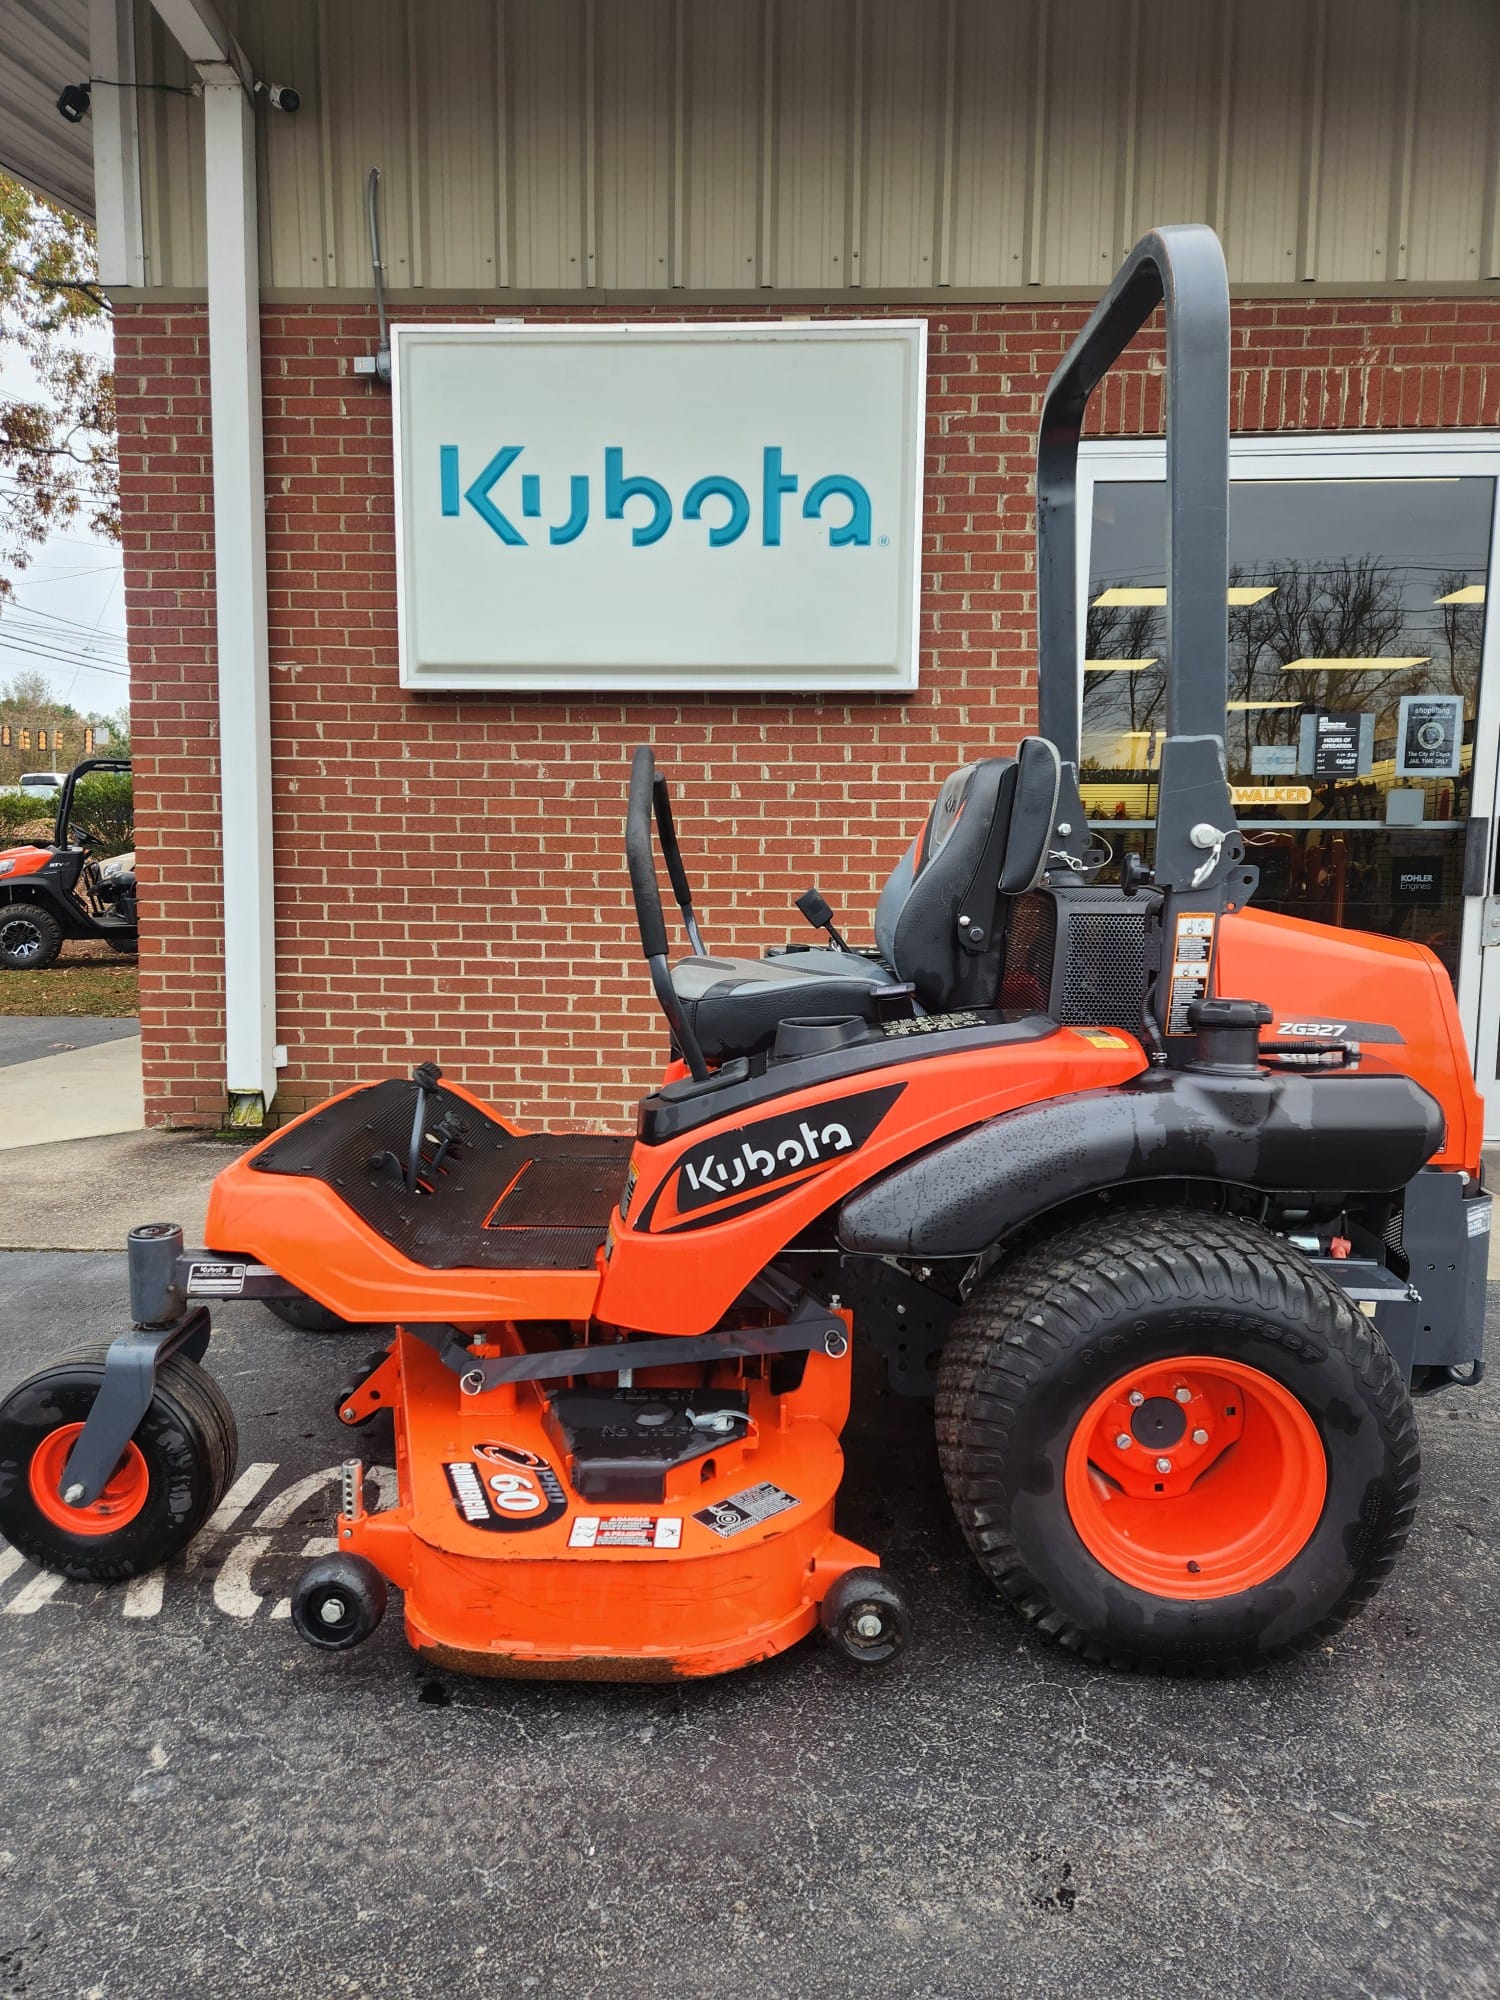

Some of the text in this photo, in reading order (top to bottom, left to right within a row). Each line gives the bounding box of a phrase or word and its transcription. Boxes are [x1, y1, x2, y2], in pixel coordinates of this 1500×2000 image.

[440, 445, 872, 547] Kubota
[1235, 788, 1307, 802] WALKER
[1400, 882, 1432, 891] Engines
[1401, 874, 1433, 882] KOHLER
[1276, 1022, 1347, 1037] ZG327
[685, 1122, 853, 1193] Kubota
[449, 1462, 490, 1521] COMMERCIAL
[490, 1473, 540, 1512] 60
[534, 1469, 567, 1504] PRO
